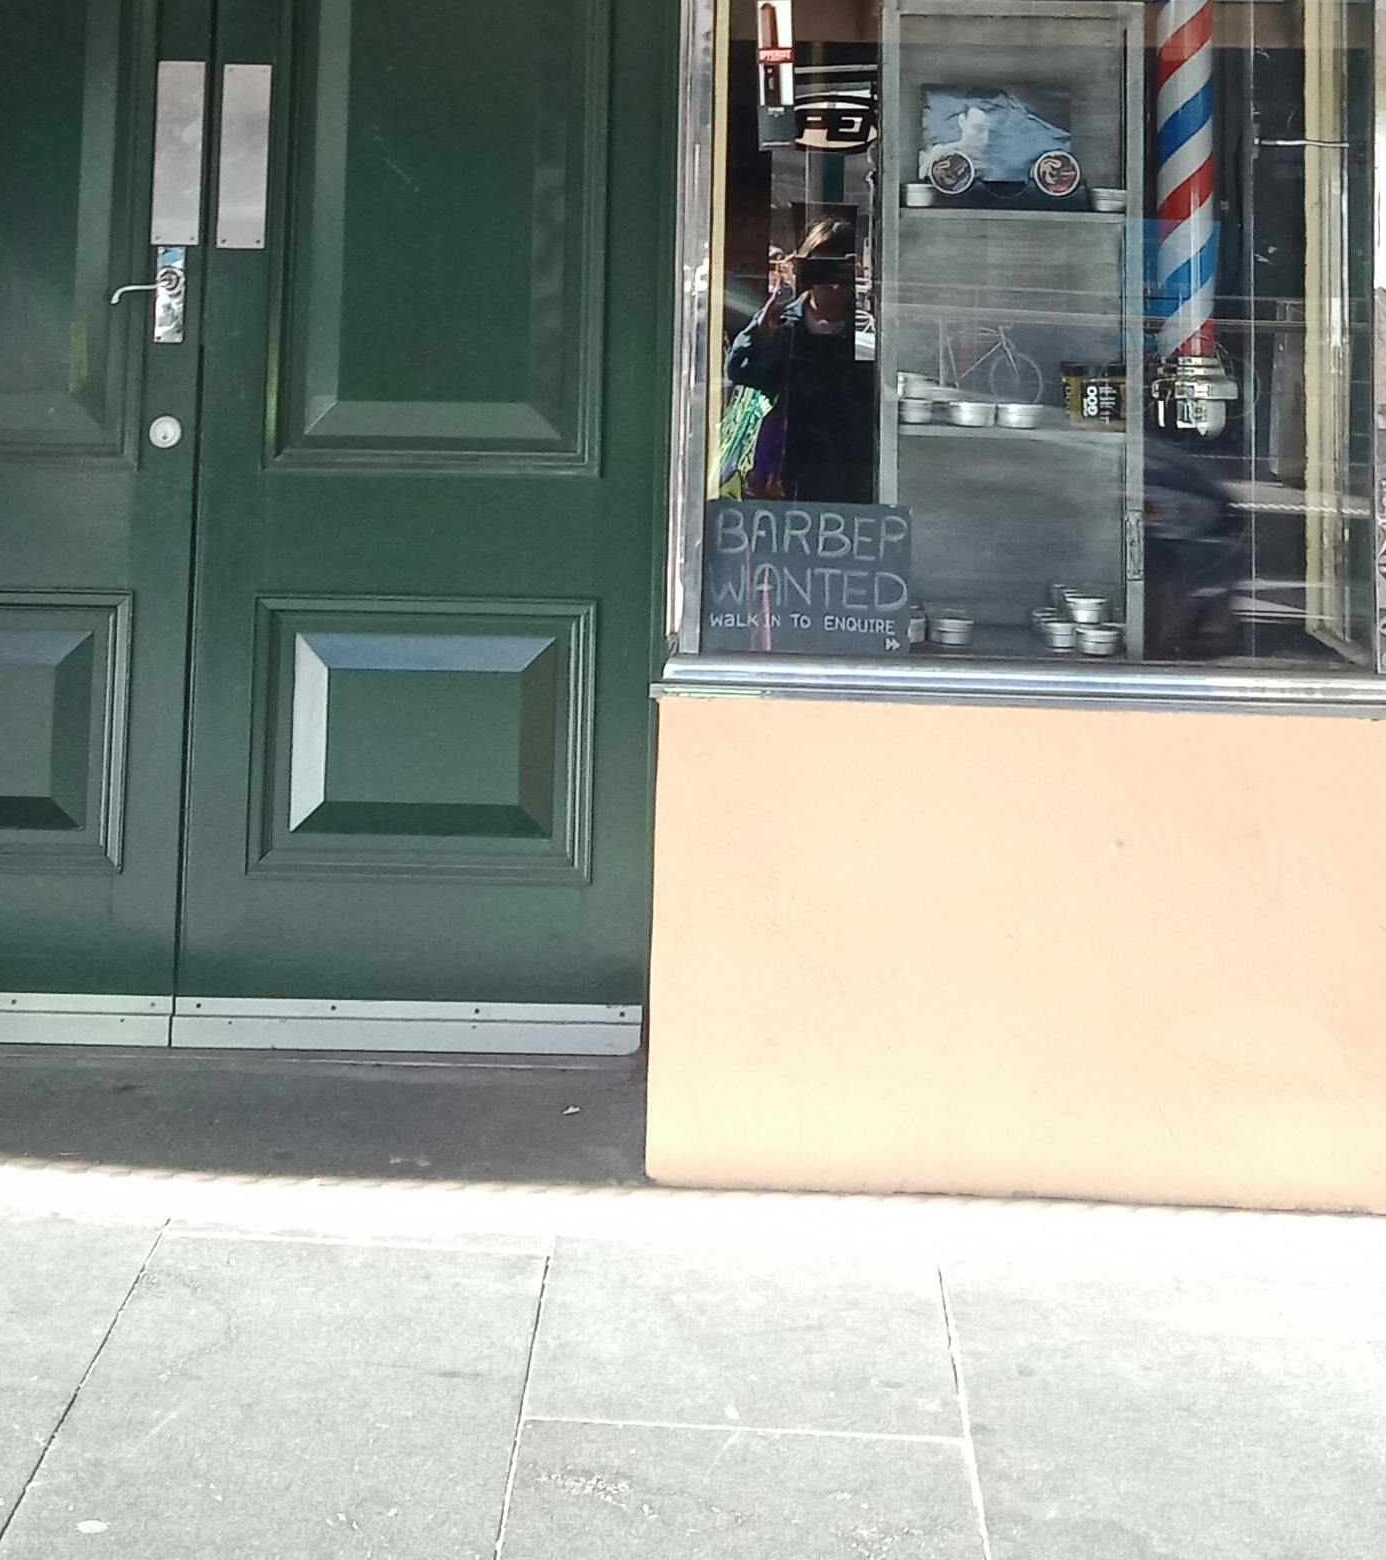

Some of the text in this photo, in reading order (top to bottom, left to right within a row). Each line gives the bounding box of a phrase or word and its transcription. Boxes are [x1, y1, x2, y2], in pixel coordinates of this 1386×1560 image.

[709, 562, 909, 613] WANTED
[789, 613, 812, 630] TO
[823, 615, 897, 637] ENQUIRE
